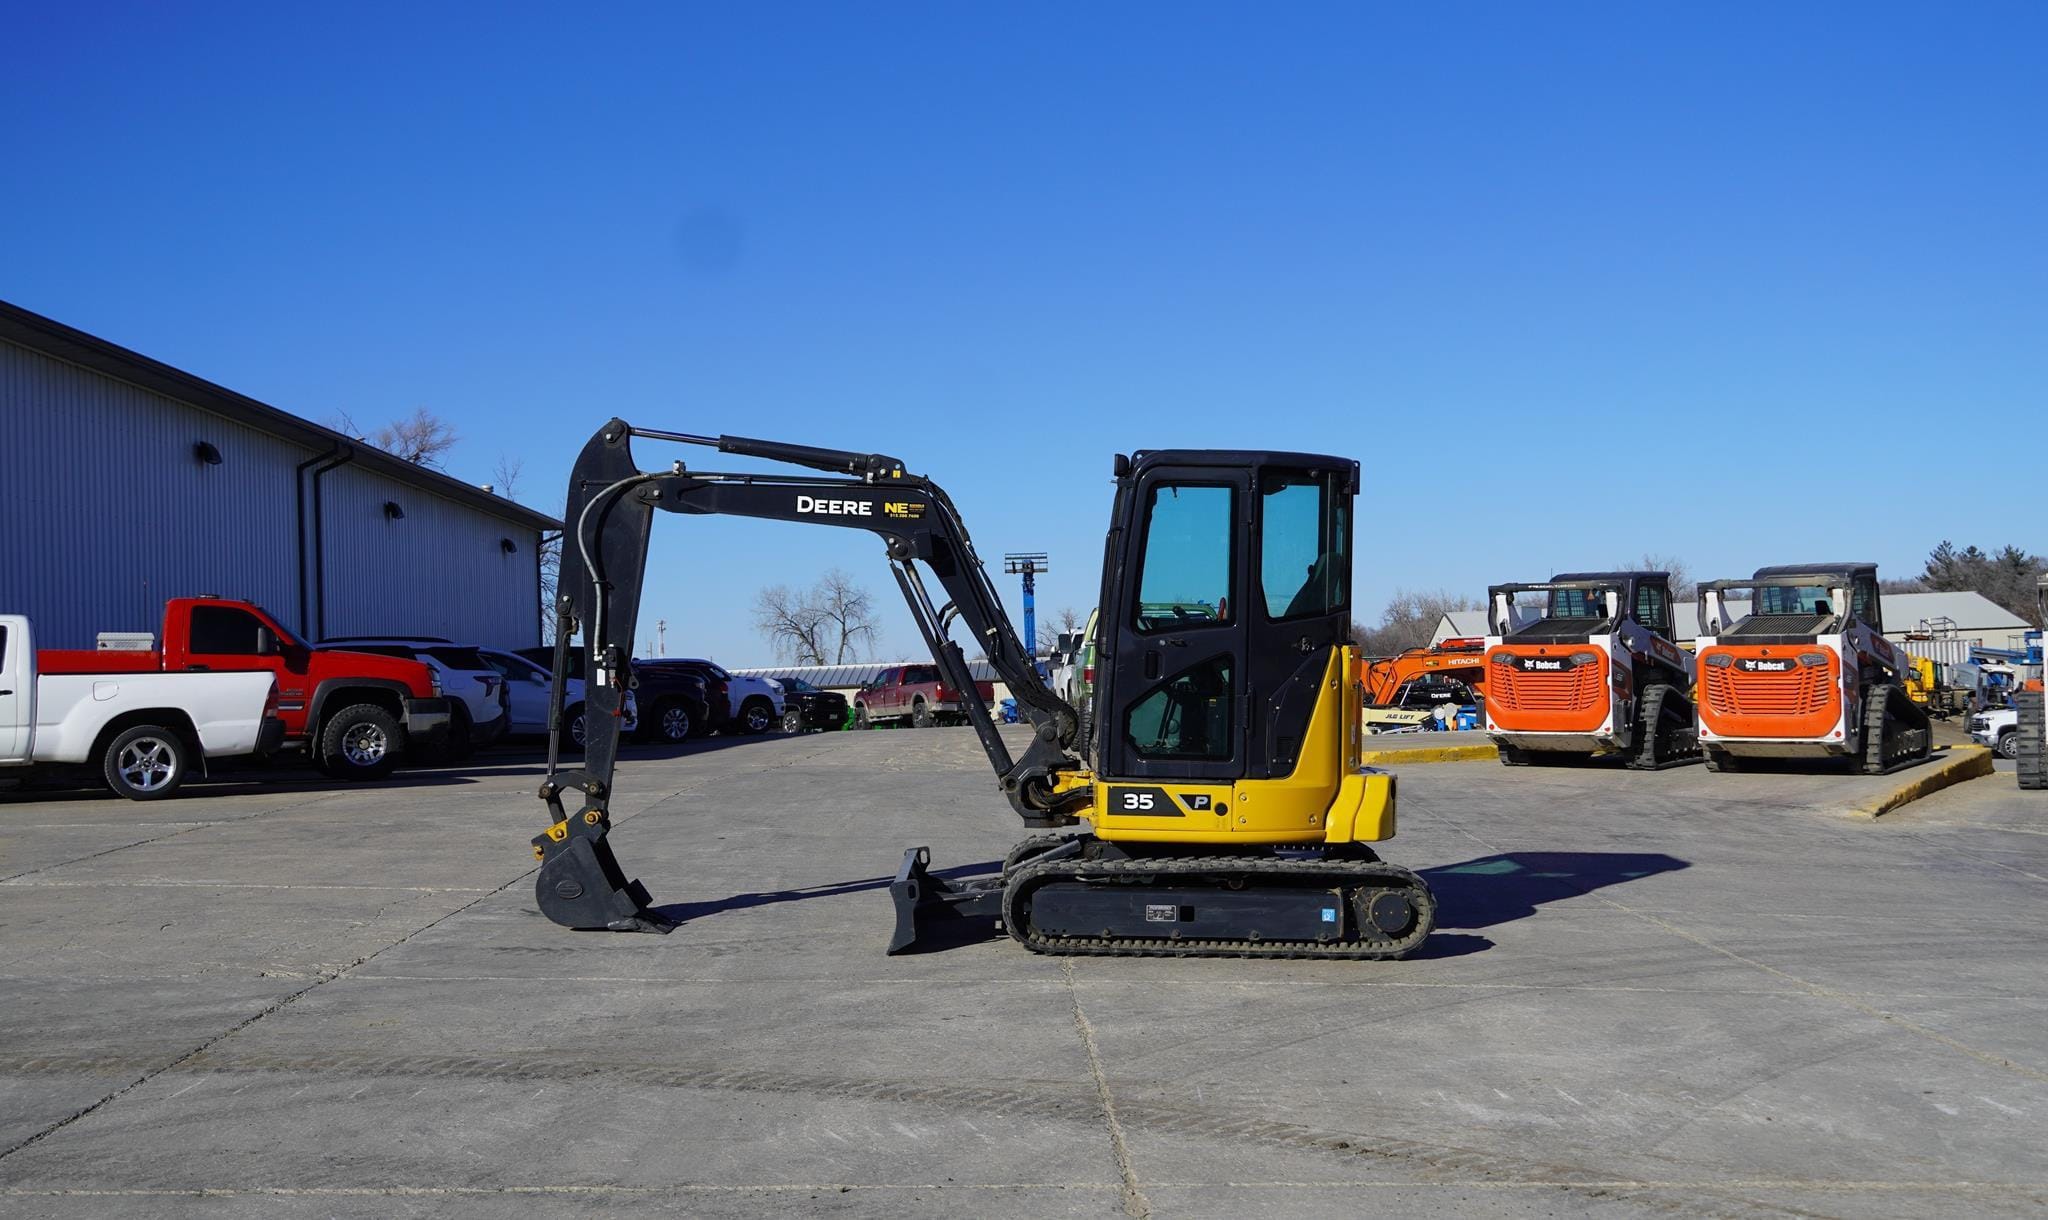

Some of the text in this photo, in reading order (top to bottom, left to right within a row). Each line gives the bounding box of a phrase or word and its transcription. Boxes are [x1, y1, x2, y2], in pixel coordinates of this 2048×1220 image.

[797, 495, 873, 516] DEERE
[884, 502, 909, 514] NE
[1448, 657, 1480, 665] HITACHI
[1535, 660, 1561, 670] Bobcat
[1757, 661, 1785, 671] Bobcat
[1123, 793, 1209, 810] 35 P
